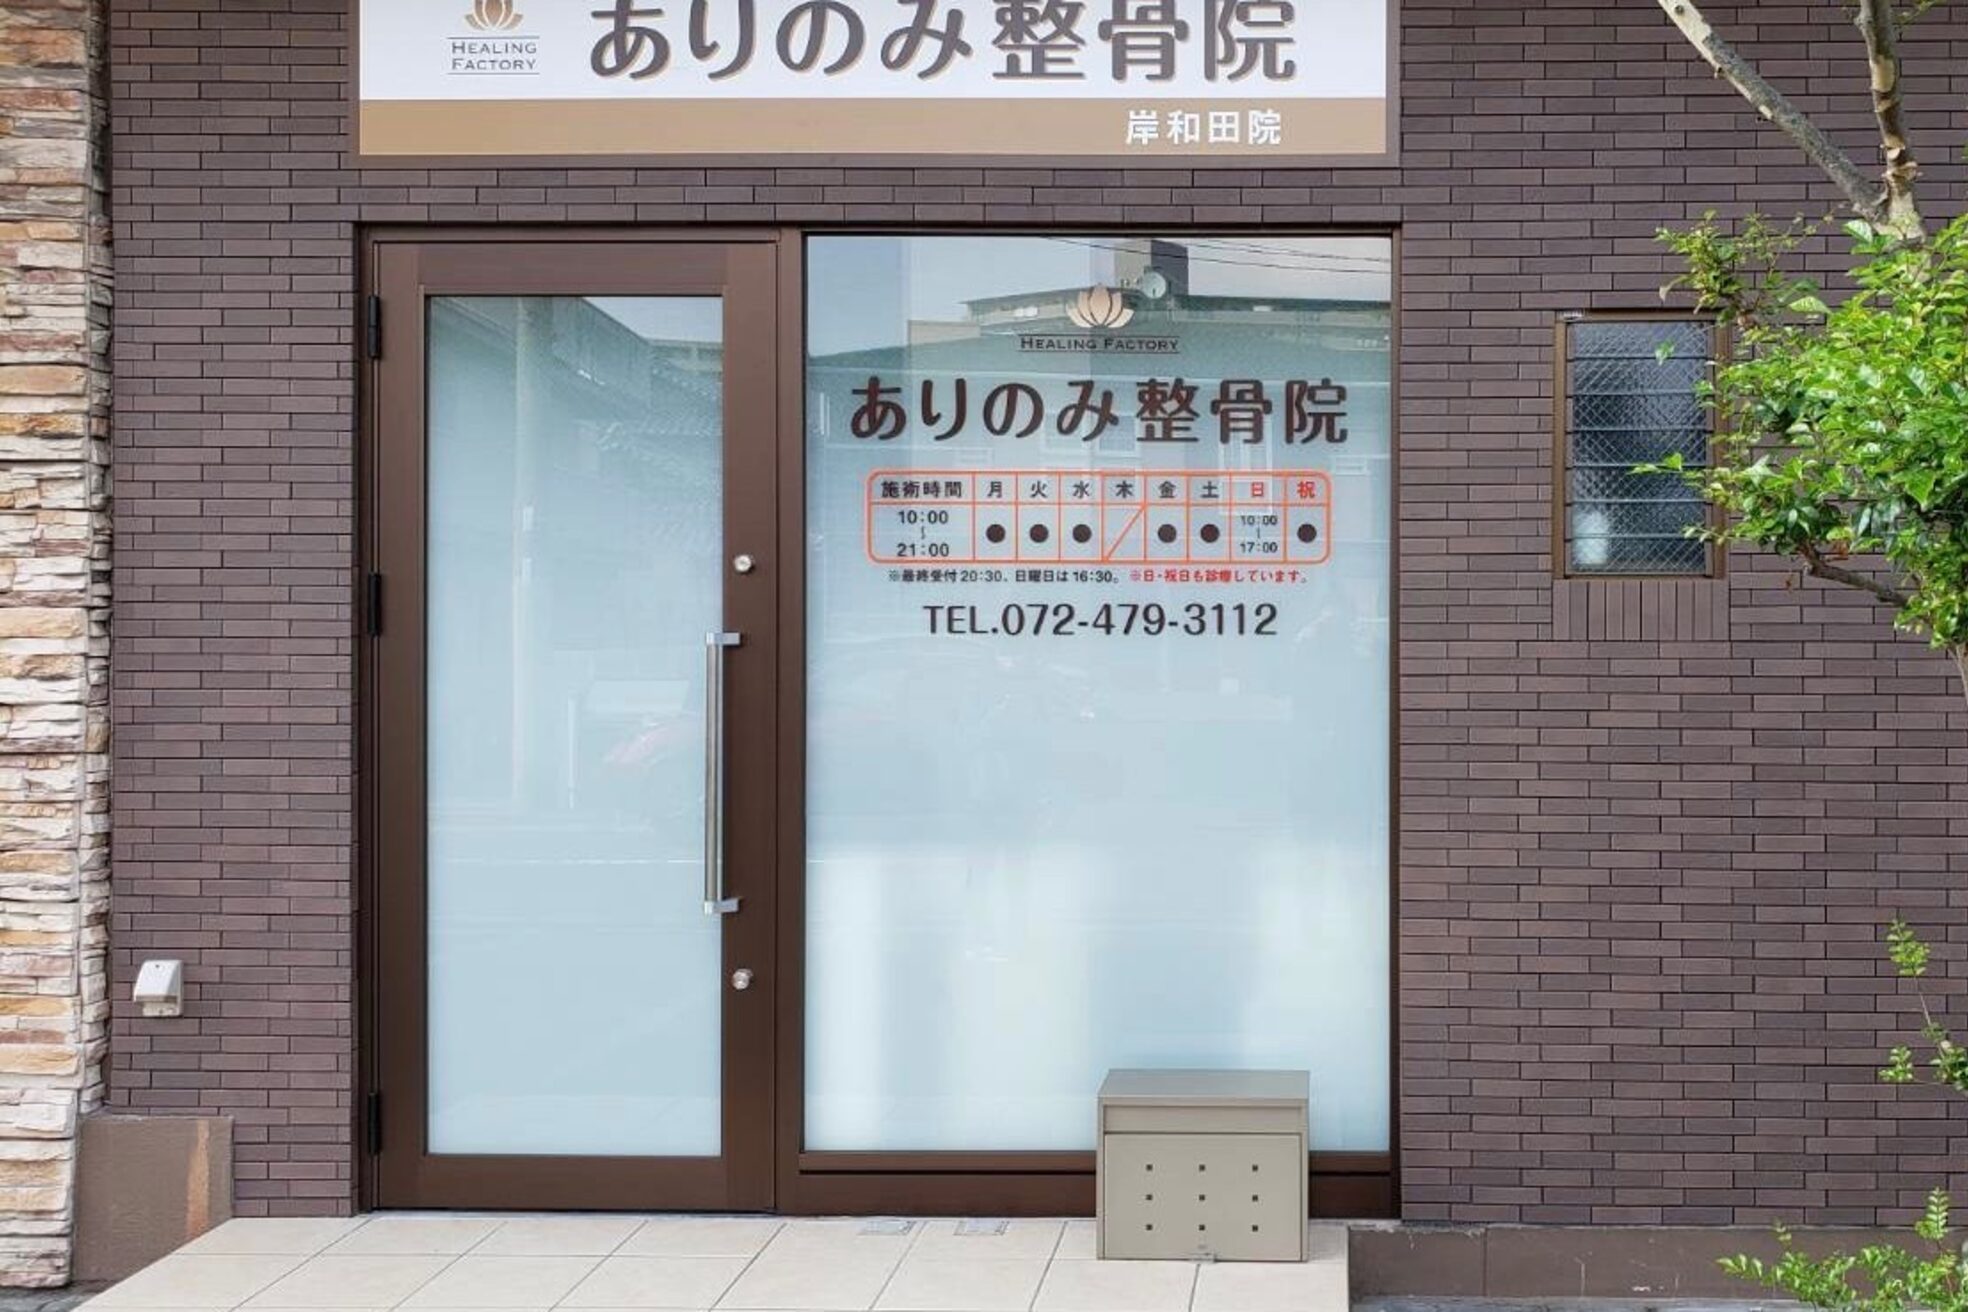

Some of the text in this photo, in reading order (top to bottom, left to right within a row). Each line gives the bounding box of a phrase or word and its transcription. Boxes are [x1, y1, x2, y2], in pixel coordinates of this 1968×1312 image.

[451, 41, 537, 54] HEALING
[590, 0, 1296, 81] ありのみ整骨院
[451, 58, 536, 70] FACTORY
[1125, 109, 1281, 145] 岸和田院
[1020, 337, 1179, 351] HEALING FACTORY
[850, 376, 1348, 444] ありのみ整骨院
[881, 481, 1316, 499] 施術時間 月 火 水 木 金 土 日 祝
[898, 510, 949, 525] 10:00
[1240, 515, 1278, 526] 10:00
[896, 543, 949, 557] 21:00
[1240, 542, 1278, 553] 17:00
[924, 603, 1277, 636] TEL.072-479-3112
